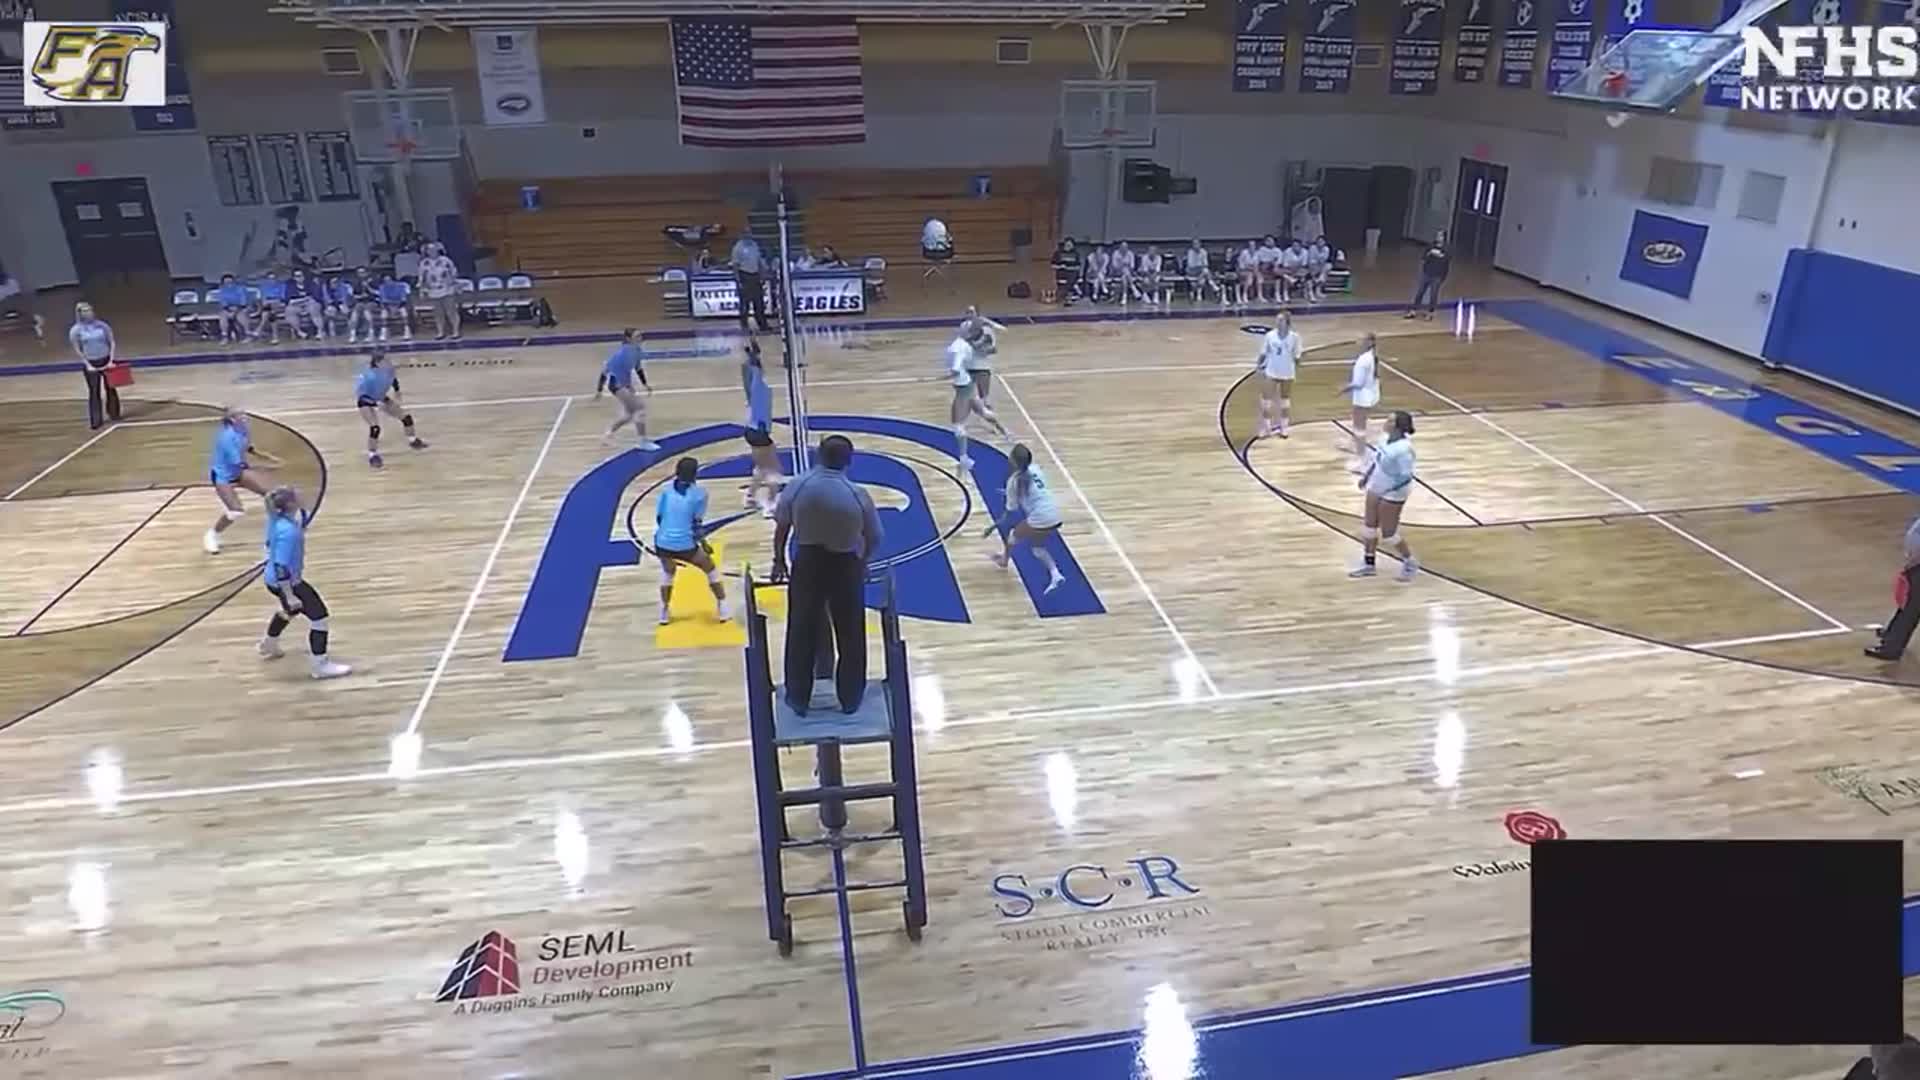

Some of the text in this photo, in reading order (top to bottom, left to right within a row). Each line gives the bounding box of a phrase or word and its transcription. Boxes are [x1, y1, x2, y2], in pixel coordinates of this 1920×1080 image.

[794, 295, 861, 311] EAGLES
[537, 930, 636, 962] SEML
[532, 951, 695, 986] Development
[453, 979, 675, 1016] A Duggins Family Company
